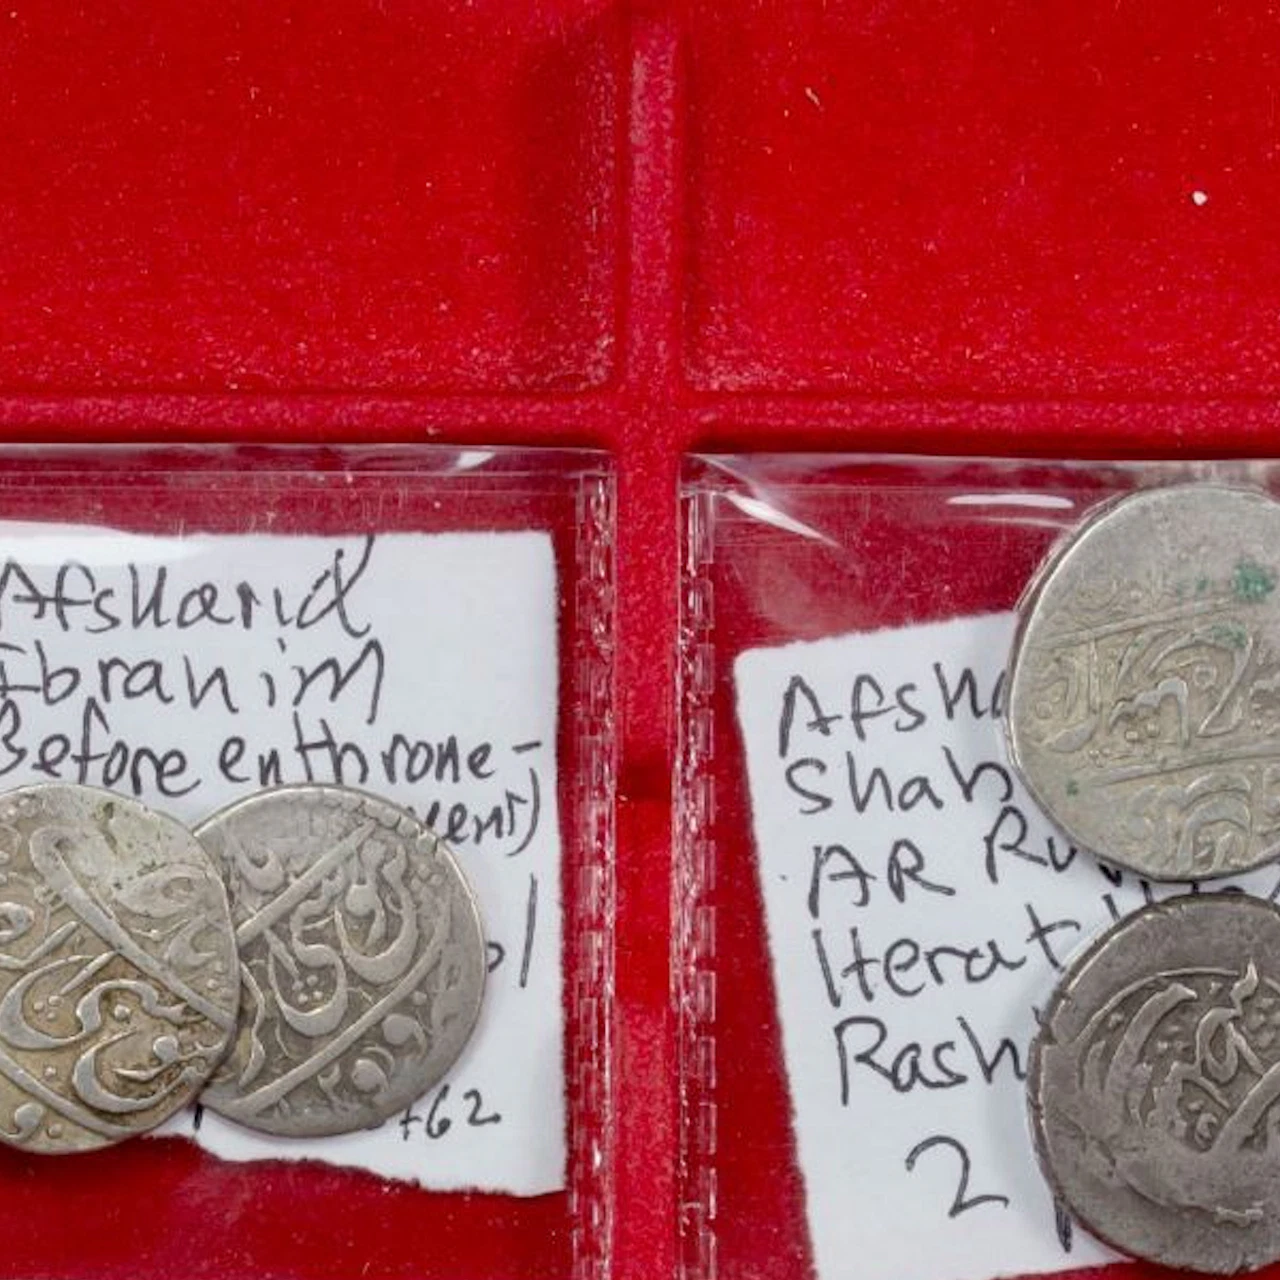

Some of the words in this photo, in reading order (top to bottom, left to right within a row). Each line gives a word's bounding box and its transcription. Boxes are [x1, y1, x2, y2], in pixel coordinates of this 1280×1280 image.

[807, 838, 956, 919] AR
[833, 1005, 1050, 1107] Rash
[904, 1135, 1011, 1220] 2
